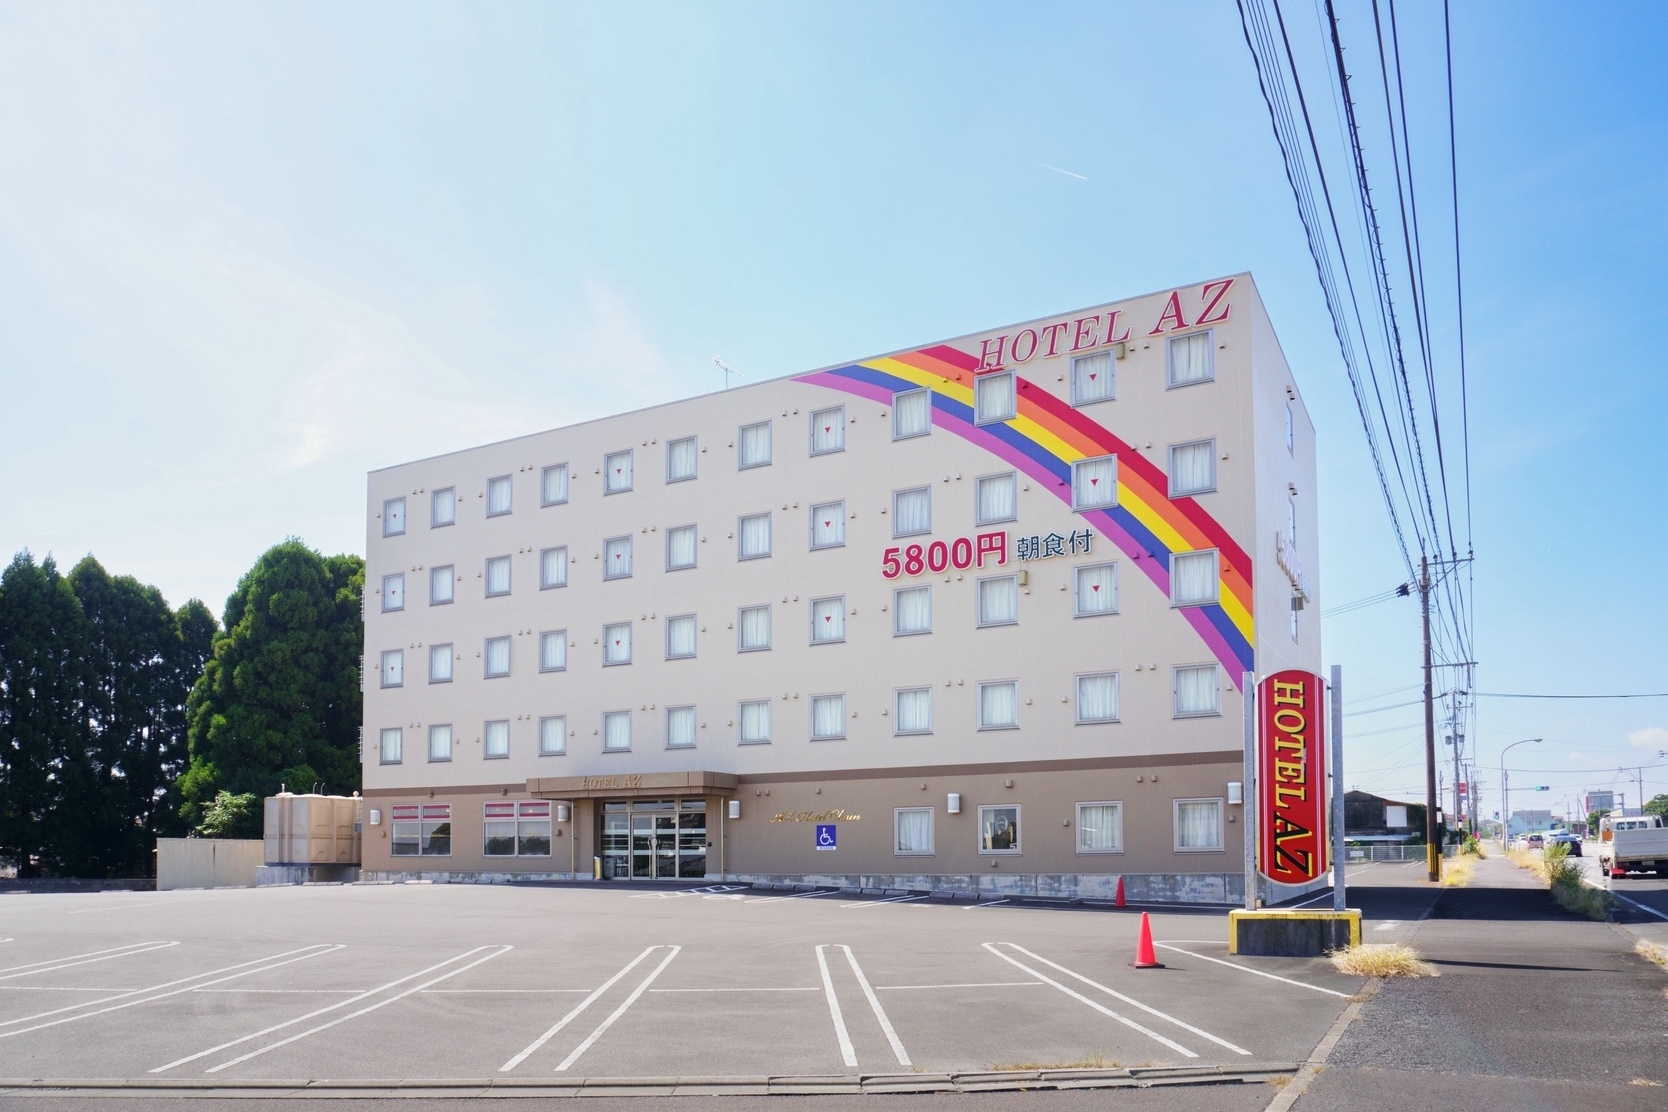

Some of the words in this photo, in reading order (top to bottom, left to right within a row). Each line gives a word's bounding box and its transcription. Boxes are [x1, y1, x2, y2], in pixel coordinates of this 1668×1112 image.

[974, 309, 1132, 373] HOTEL
[1148, 278, 1235, 336] AZ
[881, 530, 1008, 580] 5800円
[1016, 528, 1094, 562] 朝食付
[1273, 679, 1306, 809] HOTEL
[581, 777, 618, 790] HOTEL
[622, 774, 641, 788] AZ
[1273, 810, 1313, 878] AZ
